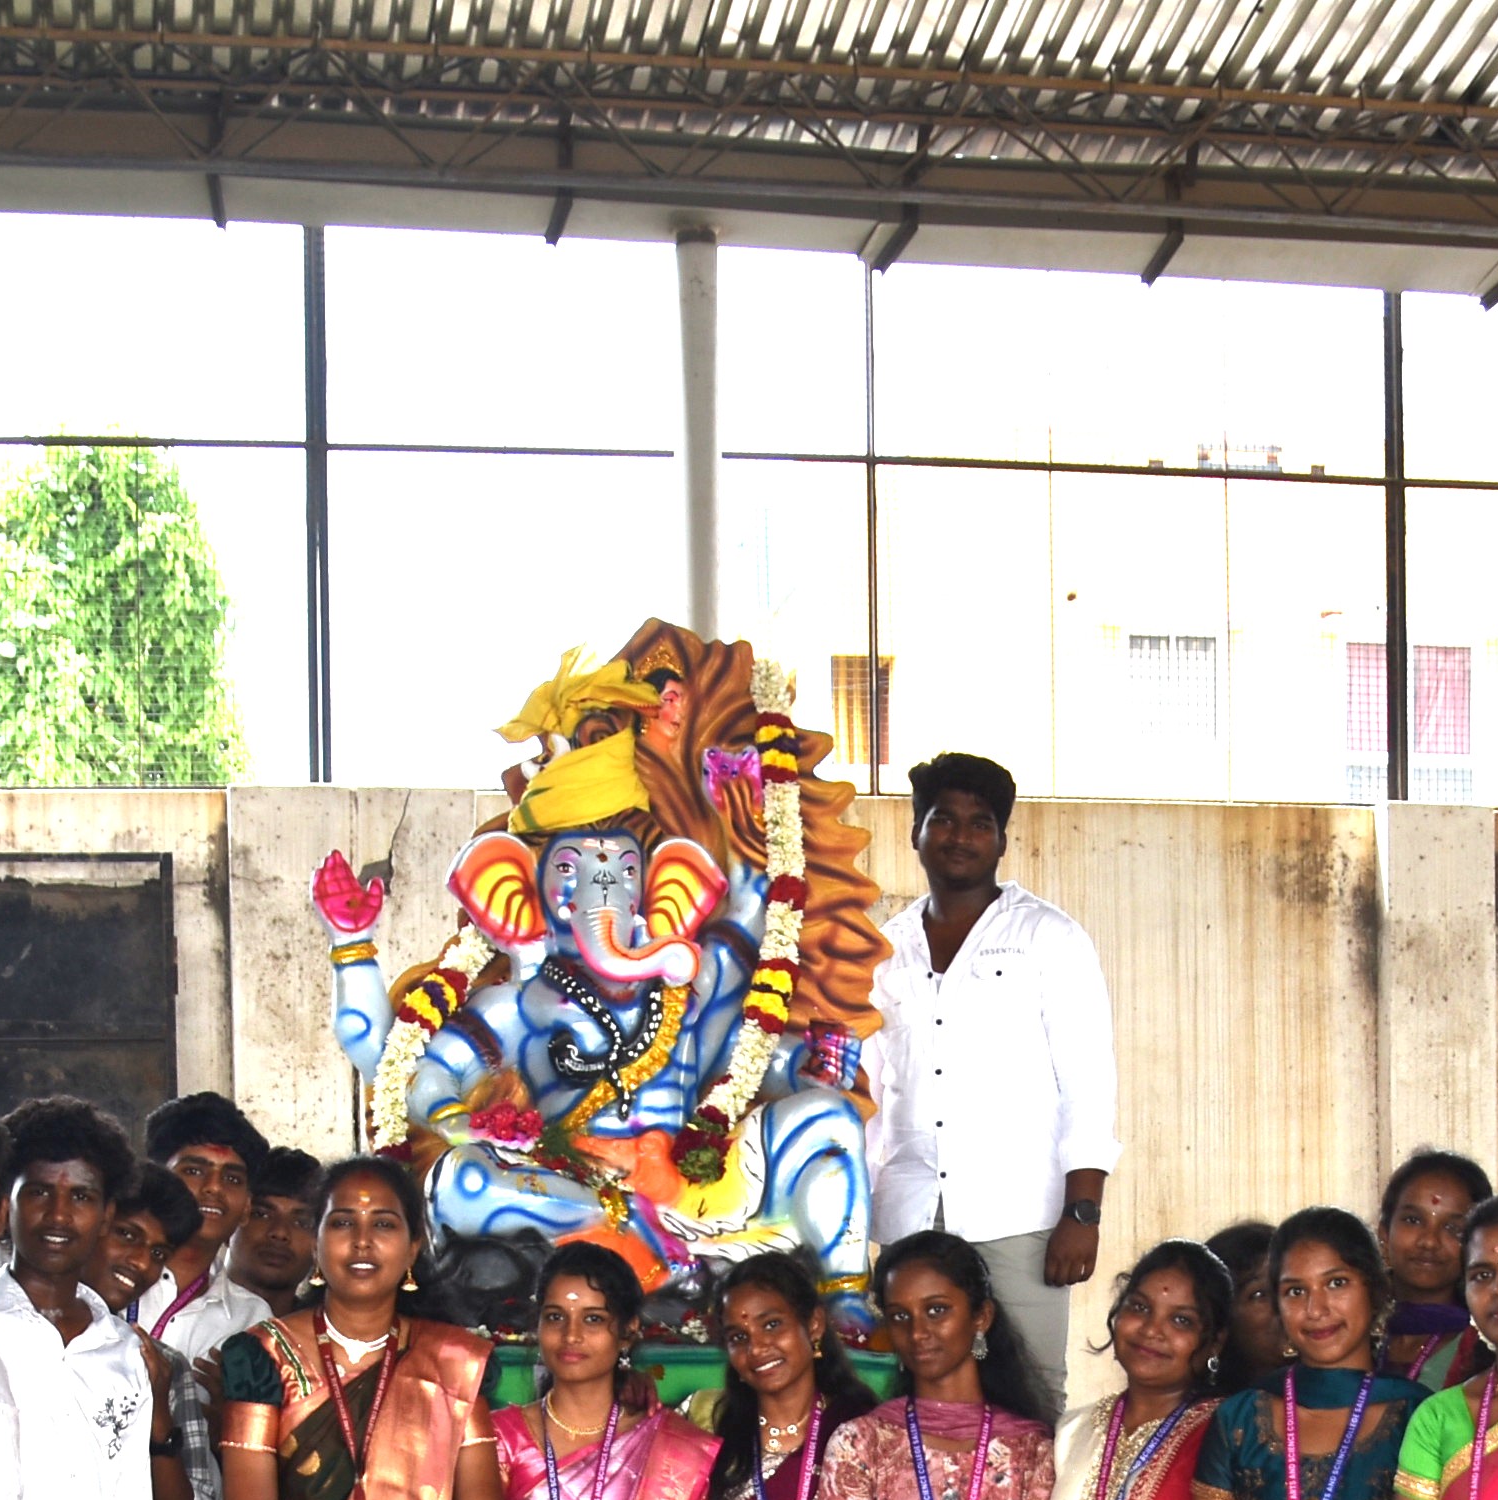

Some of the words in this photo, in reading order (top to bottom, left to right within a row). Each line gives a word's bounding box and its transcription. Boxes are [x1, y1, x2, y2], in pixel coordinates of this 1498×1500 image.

[1286, 1402, 1294, 1432] COLLEGE
[1477, 1407, 1488, 1438] COLLEGE
[603, 1425, 615, 1452] COLLEGE
[805, 1442, 816, 1471] COLLEGE
[811, 1419, 820, 1440] SALEM
[910, 1423, 919, 1445] SALEM
[980, 1422, 989, 1445] SALEM
[1287, 1433, 1296, 1462] SCIENCE
[1326, 1476, 1337, 1492] AND
[1332, 1445, 1348, 1475] SCIENCE
[1344, 1413, 1360, 1443] COLLEGE
[1354, 1389, 1367, 1412] SALEM
[597, 1453, 608, 1481] SCIENCE
[913, 1445, 925, 1474] COLLEGE
[975, 1445, 986, 1474] COLLEGE
[1472, 1440, 1483, 1471] SCIENCE
[548, 1460, 557, 1487] SCIENCE
[1288, 1463, 1296, 1479] AND
[1471, 1472, 1479, 1489] AND
[595, 1481, 603, 1497] AND
[1289, 1480, 1297, 1499] ARTS
